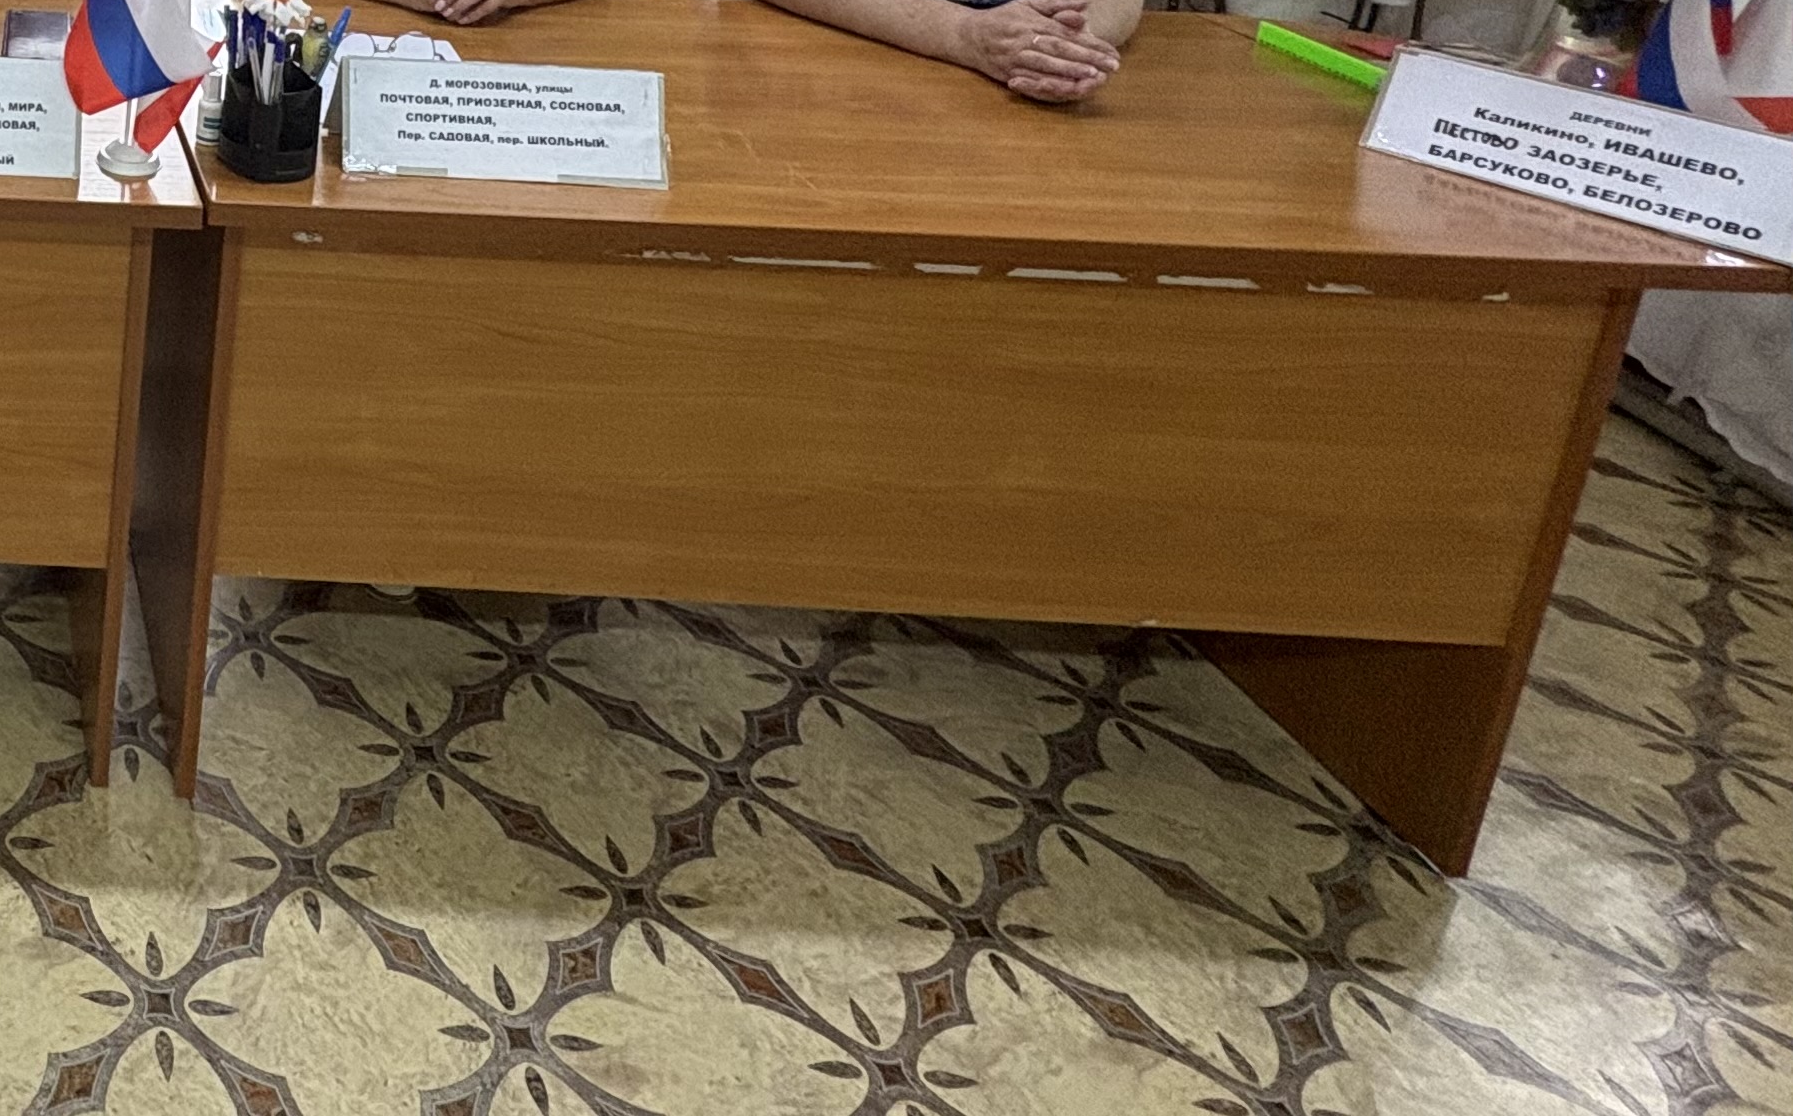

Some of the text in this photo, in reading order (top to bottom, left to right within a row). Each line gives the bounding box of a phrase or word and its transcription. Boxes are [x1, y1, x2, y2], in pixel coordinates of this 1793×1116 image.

[429, 80, 573, 94] Д. МОРОЗОВИЦА, улицы
[9, 103, 47, 114] МИРА,
[380, 94, 625, 114] ПОЧТОВАЯ, ПРИОЗЕРНАЯ, СОСНОВАЯ,
[406, 113, 496, 126] СПОРТИВНАЯ,
[1569, 111, 1652, 136] ДЕРЕВНИ
[398, 131, 425, 141] Пер.
[1474, 107, 1744, 185] Каликино, ИВАШЕВО,
[1527, 145, 1662, 191] ЗАОЗЕРЬЕ,
[1428, 145, 1763, 240] БАРСУКОВО, БЕЛОЗЕРОВО
